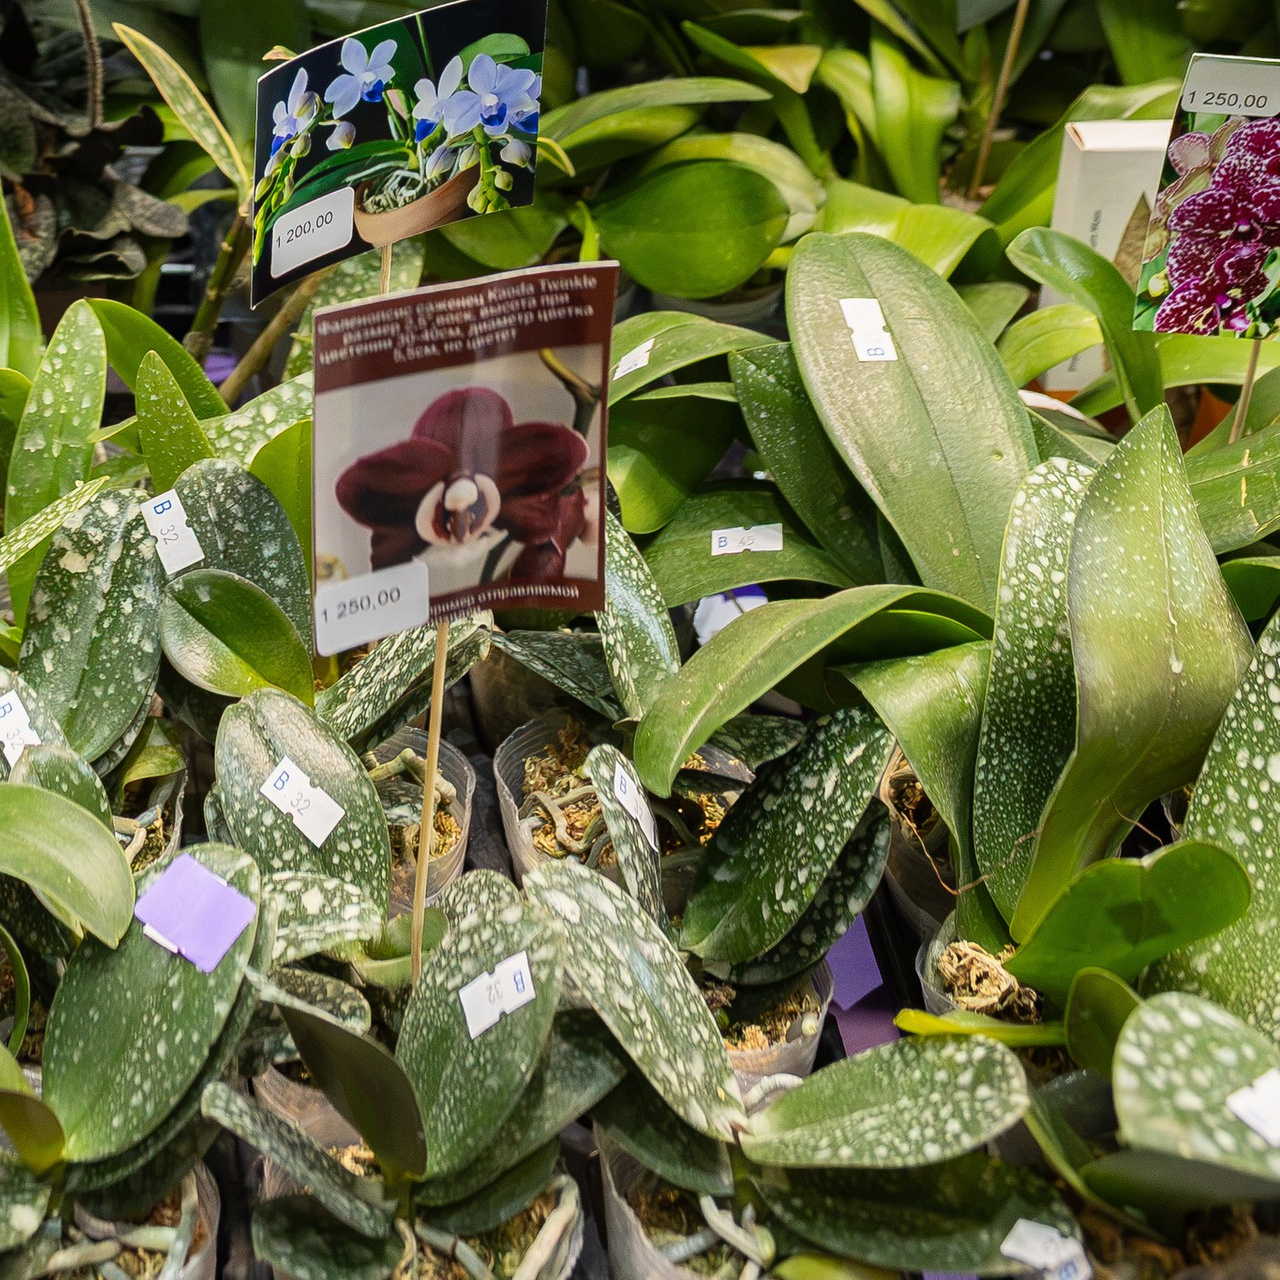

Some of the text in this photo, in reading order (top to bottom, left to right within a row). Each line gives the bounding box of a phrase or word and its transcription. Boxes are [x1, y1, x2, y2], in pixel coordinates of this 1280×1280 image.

[1187, 90, 1268, 109] 1 250,00
[275, 211, 334, 248] 1 200,00
[318, 305, 412, 336] Фаленопсис
[416, 294, 485, 319] саженец
[539, 274, 598, 291] Twinkle
[343, 321, 401, 346] размер
[479, 296, 536, 319] высота
[540, 292, 570, 309] при
[320, 337, 393, 366] цветении
[469, 311, 535, 338] диаметр
[537, 303, 594, 323] цветка
[444, 339, 464, 354] не
[466, 328, 517, 351] цветет
[160, 524, 180, 546] 32
[477, 584, 580, 604] отправляемой
[321, 609, 328, 624] 1
[290, 791, 311, 817] 32
